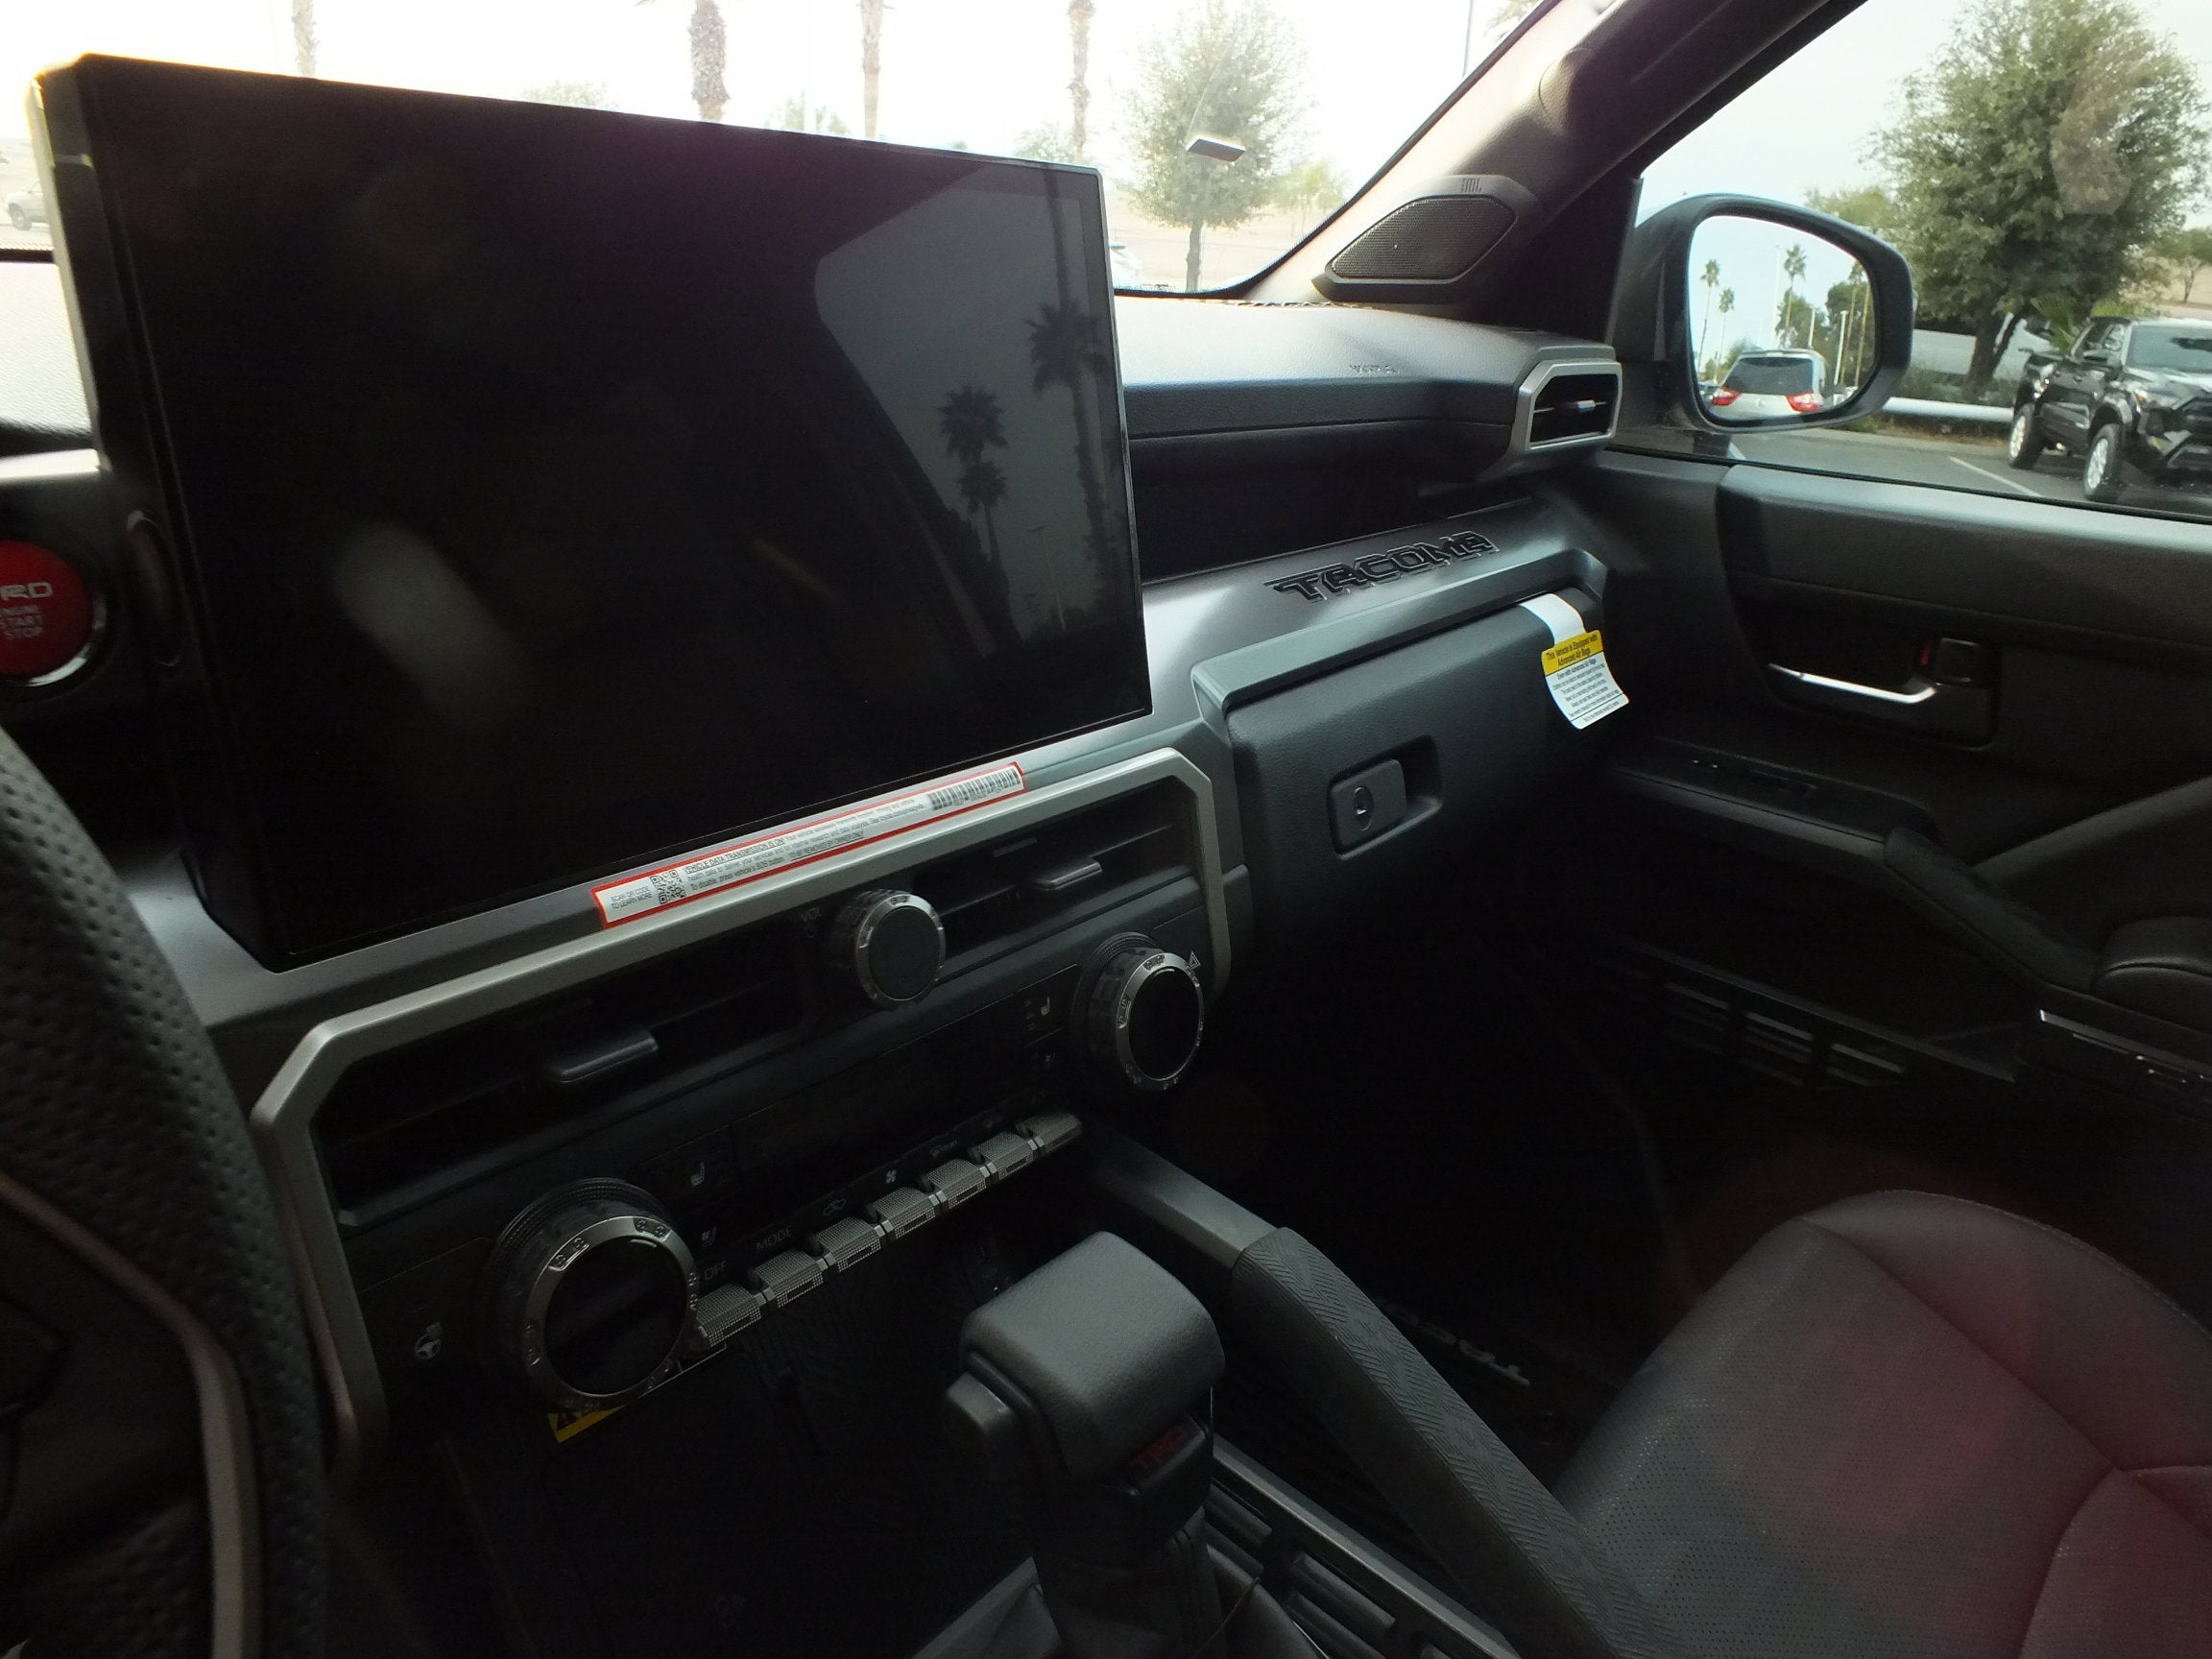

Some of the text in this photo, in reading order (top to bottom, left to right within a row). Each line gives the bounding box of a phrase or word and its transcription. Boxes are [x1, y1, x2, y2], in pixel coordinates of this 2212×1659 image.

[1462, 178, 1481, 192] JBL
[1264, 531, 1497, 599] TACOMA
[0, 582, 53, 601] RD
[685, 860, 710, 874] VEHICLE
[709, 856, 725, 866] DATA
[726, 843, 767, 861] TRANSMISSION
[756, 861, 769, 870] SOS
[611, 894, 627, 903] SCAN
[635, 886, 651, 896] CODE
[619, 897, 637, 907] LEARN
[637, 892, 653, 902] MORE
[754, 1225, 793, 1252] MODE
[705, 1261, 730, 1280] OFF
